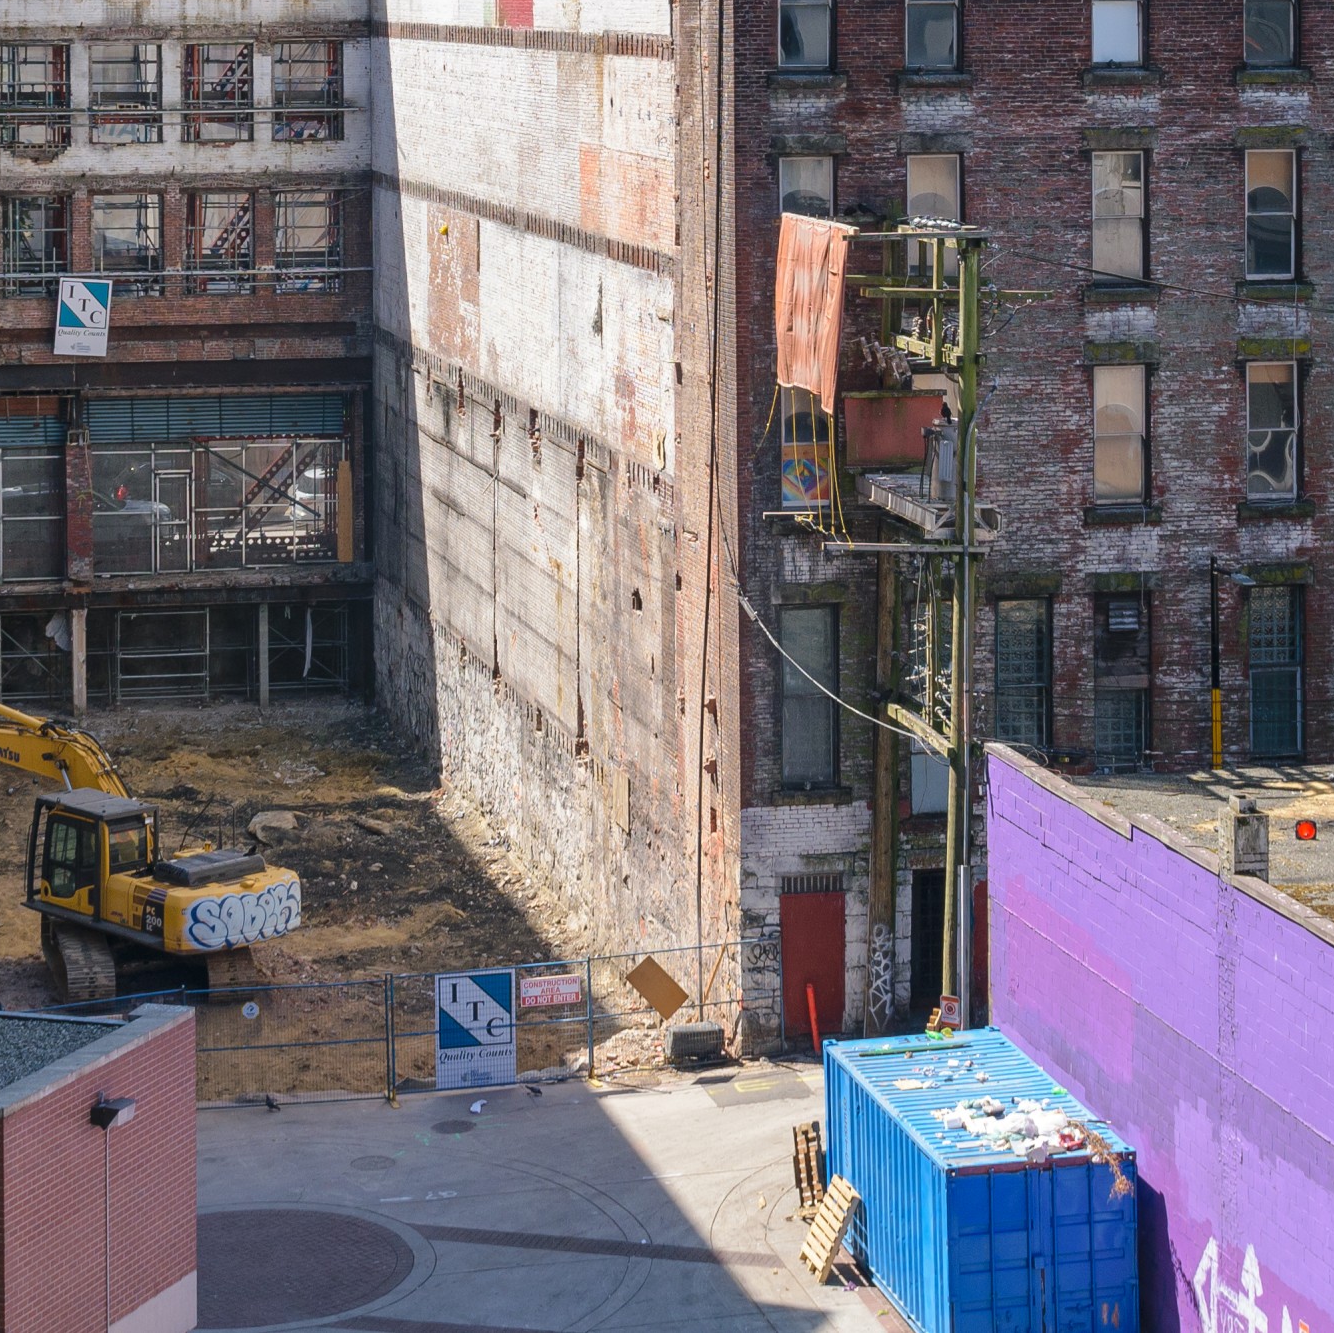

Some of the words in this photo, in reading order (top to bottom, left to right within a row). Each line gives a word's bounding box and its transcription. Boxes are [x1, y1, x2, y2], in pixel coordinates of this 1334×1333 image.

[58, 329, 81, 337] Quality
[146, 906, 156, 916] PC
[146, 915, 163, 927] 200
[146, 924, 153, 932] LC
[523, 978, 578, 989] CONSTRUCTION
[540, 987, 561, 995] AREA
[525, 997, 535, 1005] DO
[537, 996, 551, 1004] NOT
[554, 994, 576, 1002] ENTER
[439, 1050, 475, 1064] Quality
[478, 1048, 513, 1058] Counts
